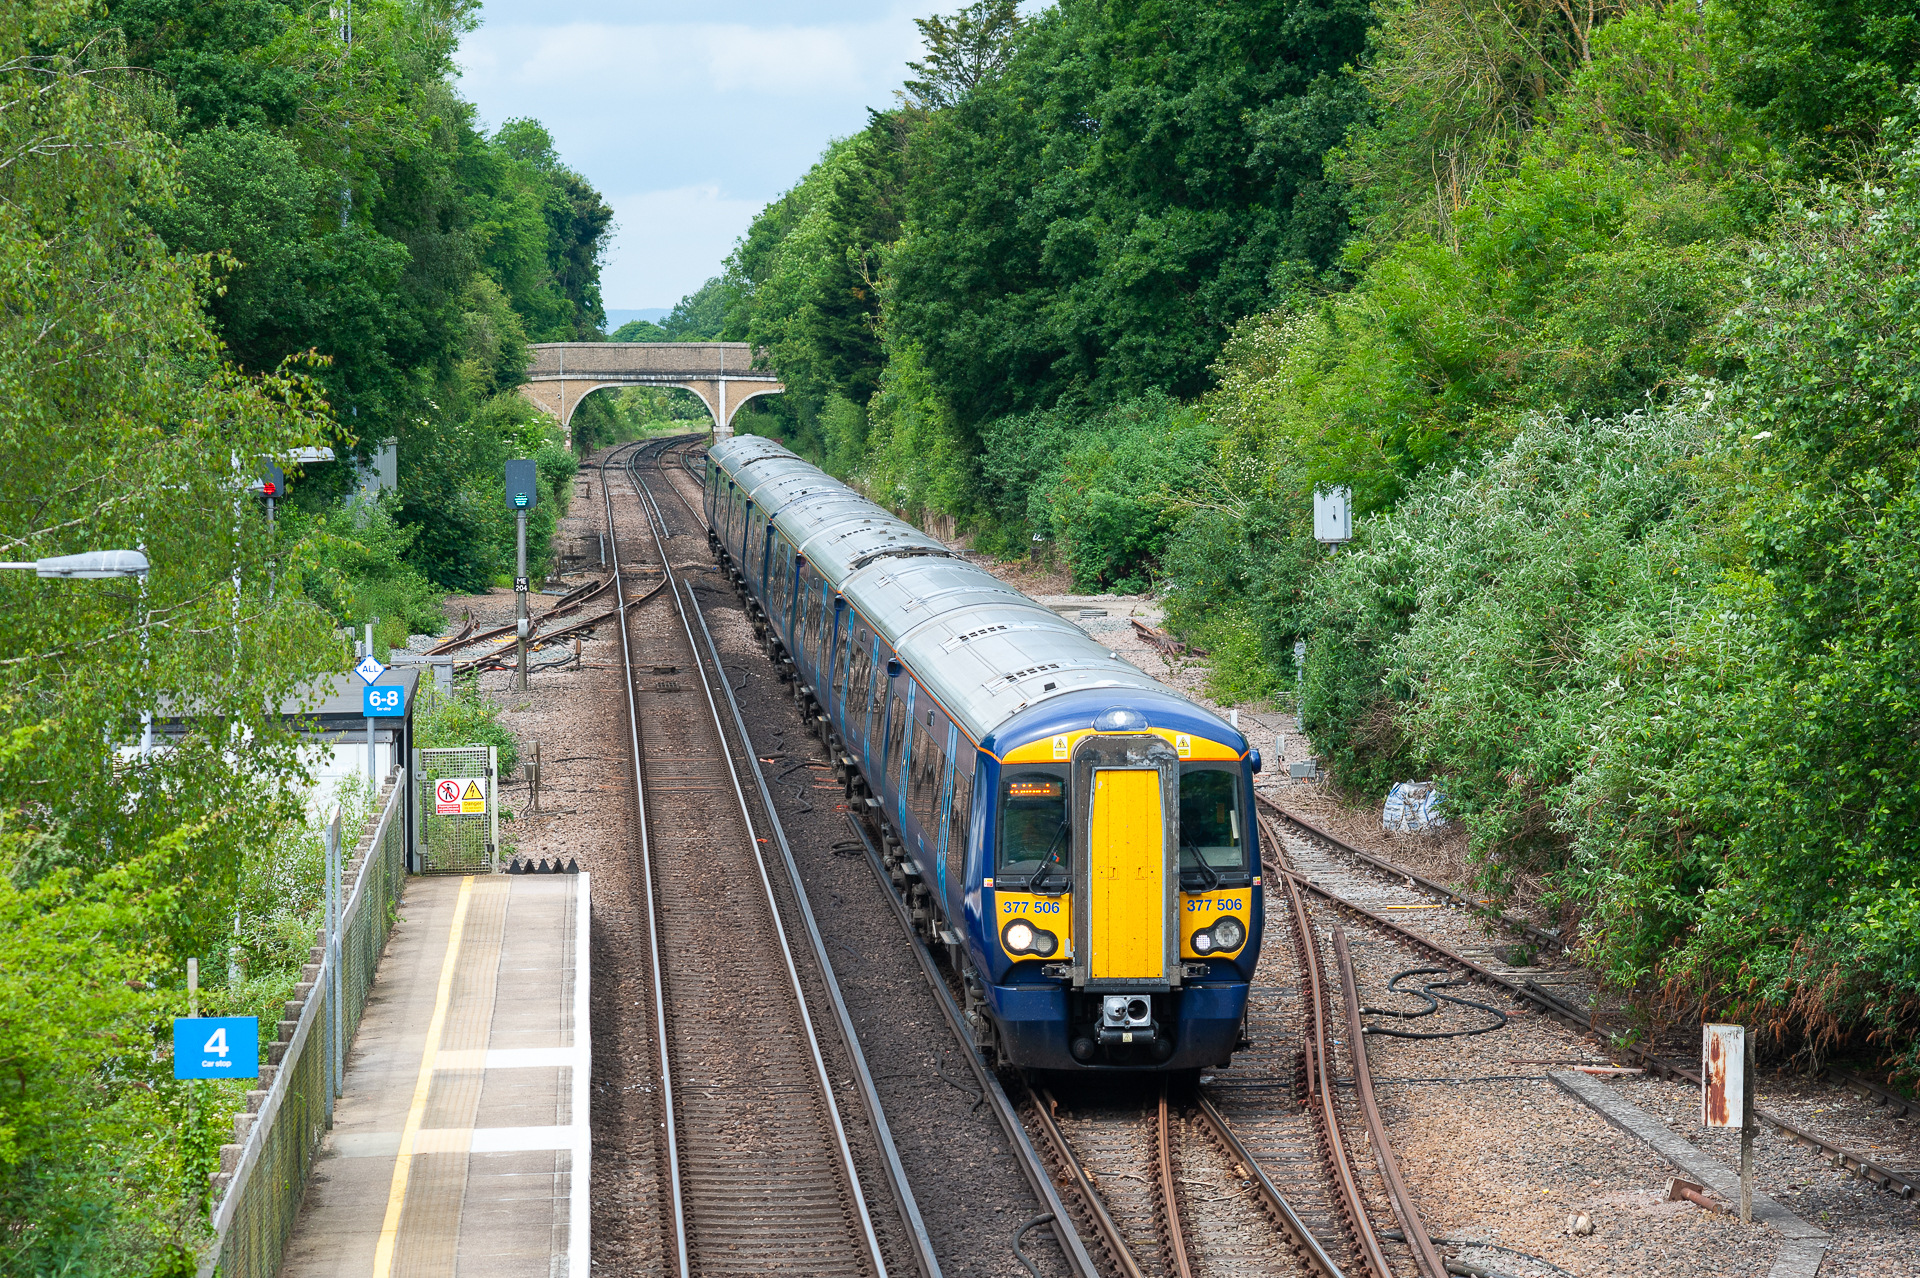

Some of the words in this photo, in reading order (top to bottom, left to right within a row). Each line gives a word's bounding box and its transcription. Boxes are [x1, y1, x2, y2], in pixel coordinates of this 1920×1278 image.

[362, 665, 380, 673] ALL
[369, 690, 399, 707] 6-8
[1003, 901, 1030, 914] 377
[1034, 901, 1060, 914] 506
[1187, 899, 1212, 912] 377
[1217, 898, 1243, 911] 506
[203, 1027, 230, 1058] 4
[201, 1060, 214, 1068] Car
[215, 1060, 232, 1068] stop
